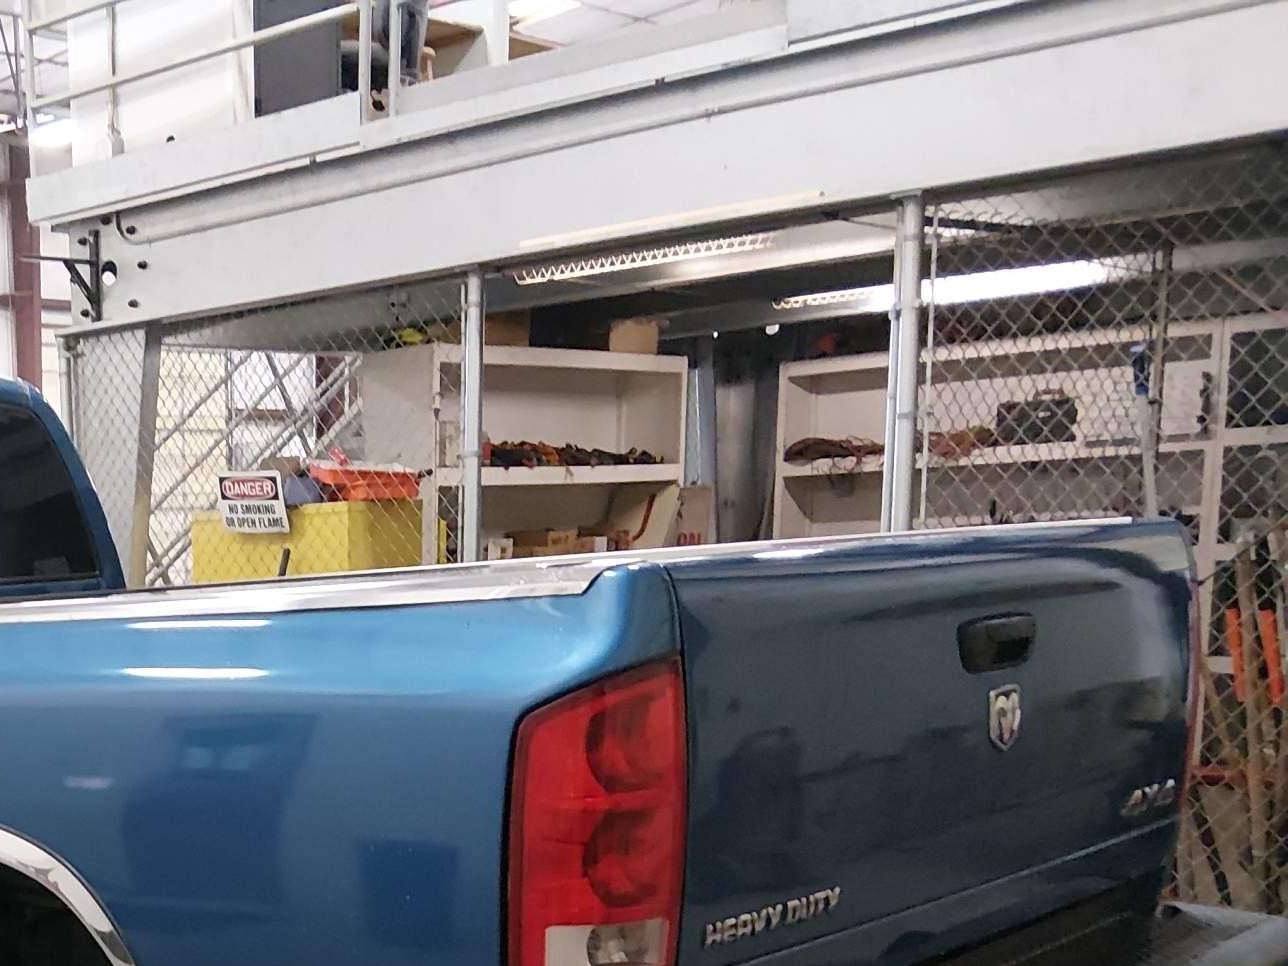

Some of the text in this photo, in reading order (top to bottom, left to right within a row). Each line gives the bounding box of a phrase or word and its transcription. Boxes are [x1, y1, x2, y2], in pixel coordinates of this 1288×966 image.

[225, 480, 271, 496] DANGER
[228, 503, 276, 515] NO SMOKING
[226, 516, 285, 529] OR OPEN FLAME
[704, 886, 841, 947] HEAVY DUTY
